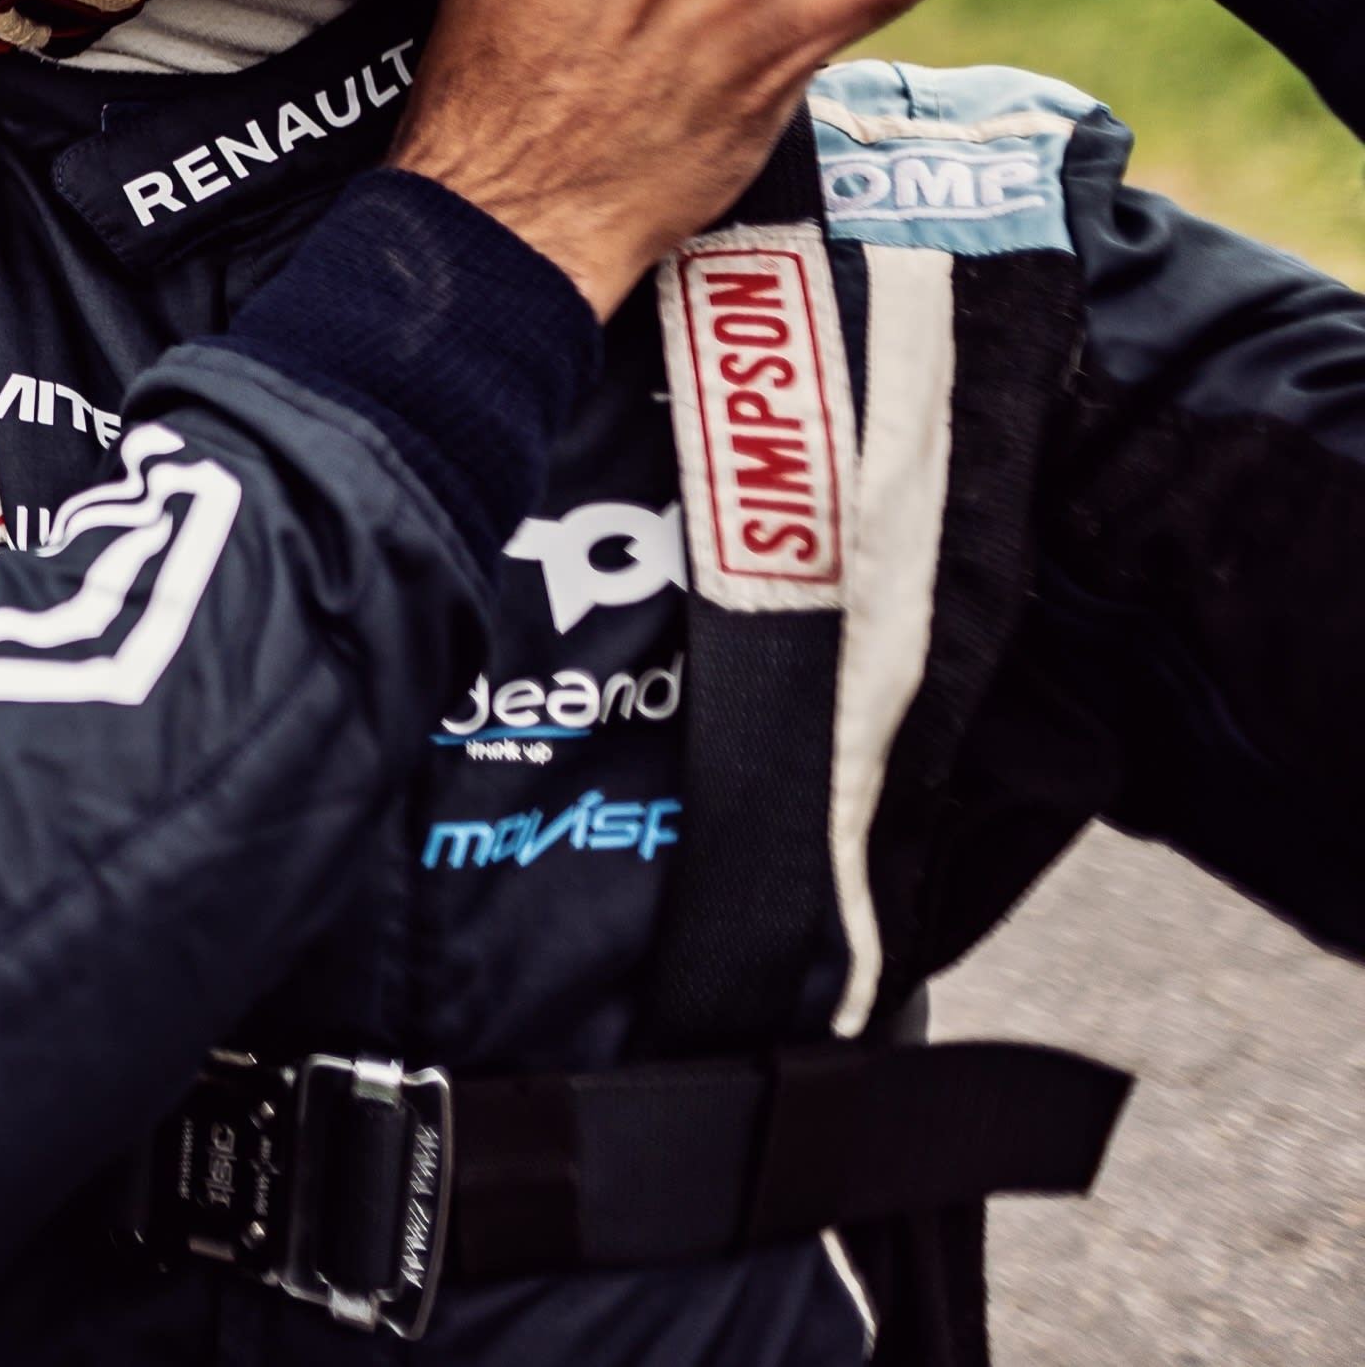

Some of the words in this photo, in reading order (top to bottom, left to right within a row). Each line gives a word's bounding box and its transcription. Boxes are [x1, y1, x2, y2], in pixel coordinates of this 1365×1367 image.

[122, 38, 415, 227] RENAULT
[822, 157, 1040, 213] OMP
[704, 268, 819, 567] SIMPSON
